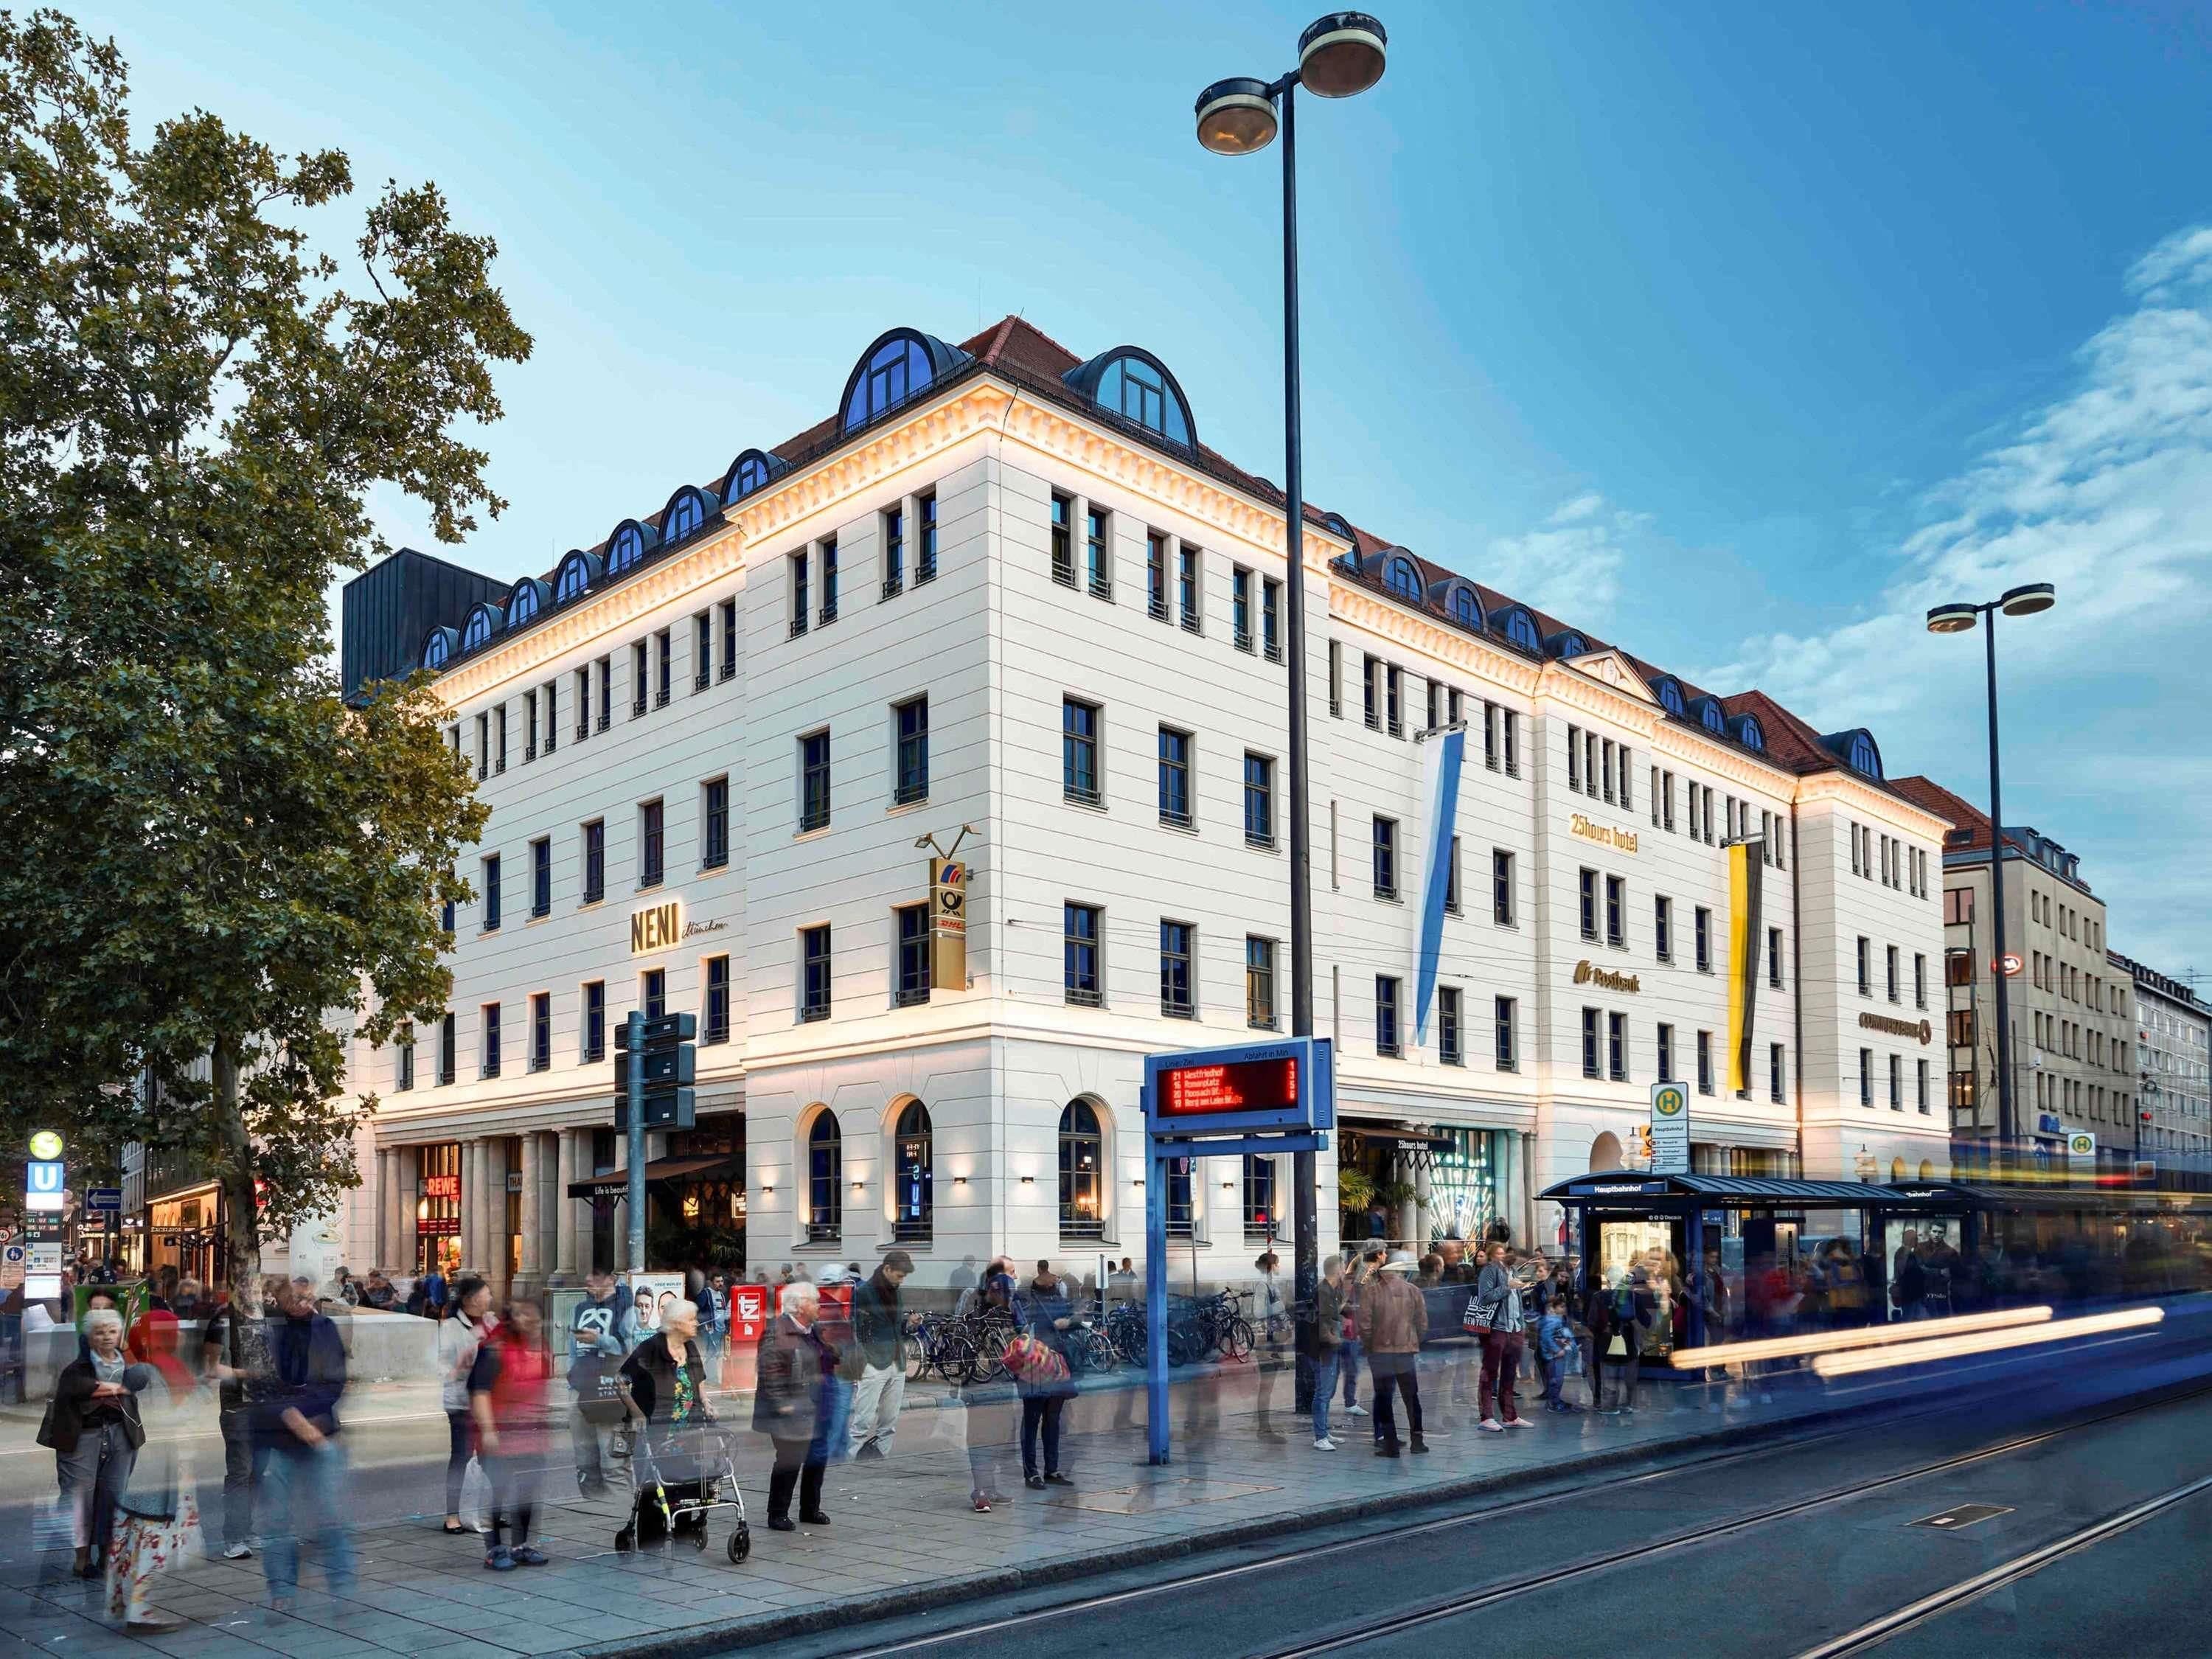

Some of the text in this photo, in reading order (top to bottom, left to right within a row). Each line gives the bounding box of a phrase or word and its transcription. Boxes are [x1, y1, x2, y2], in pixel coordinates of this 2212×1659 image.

[1571, 813, 1638, 853] 25hours hotel
[631, 902, 678, 953] NENI
[940, 919, 962, 929] DHL
[1593, 967, 1640, 993] Postbank
[1398, 1139, 1428, 1150] 25hours hotel
[34, 1166, 57, 1191] U
[428, 1177, 458, 1195] REWE
[594, 1186, 604, 1195] Life
[1594, 1185, 1642, 1194] Hauptbahnhof
